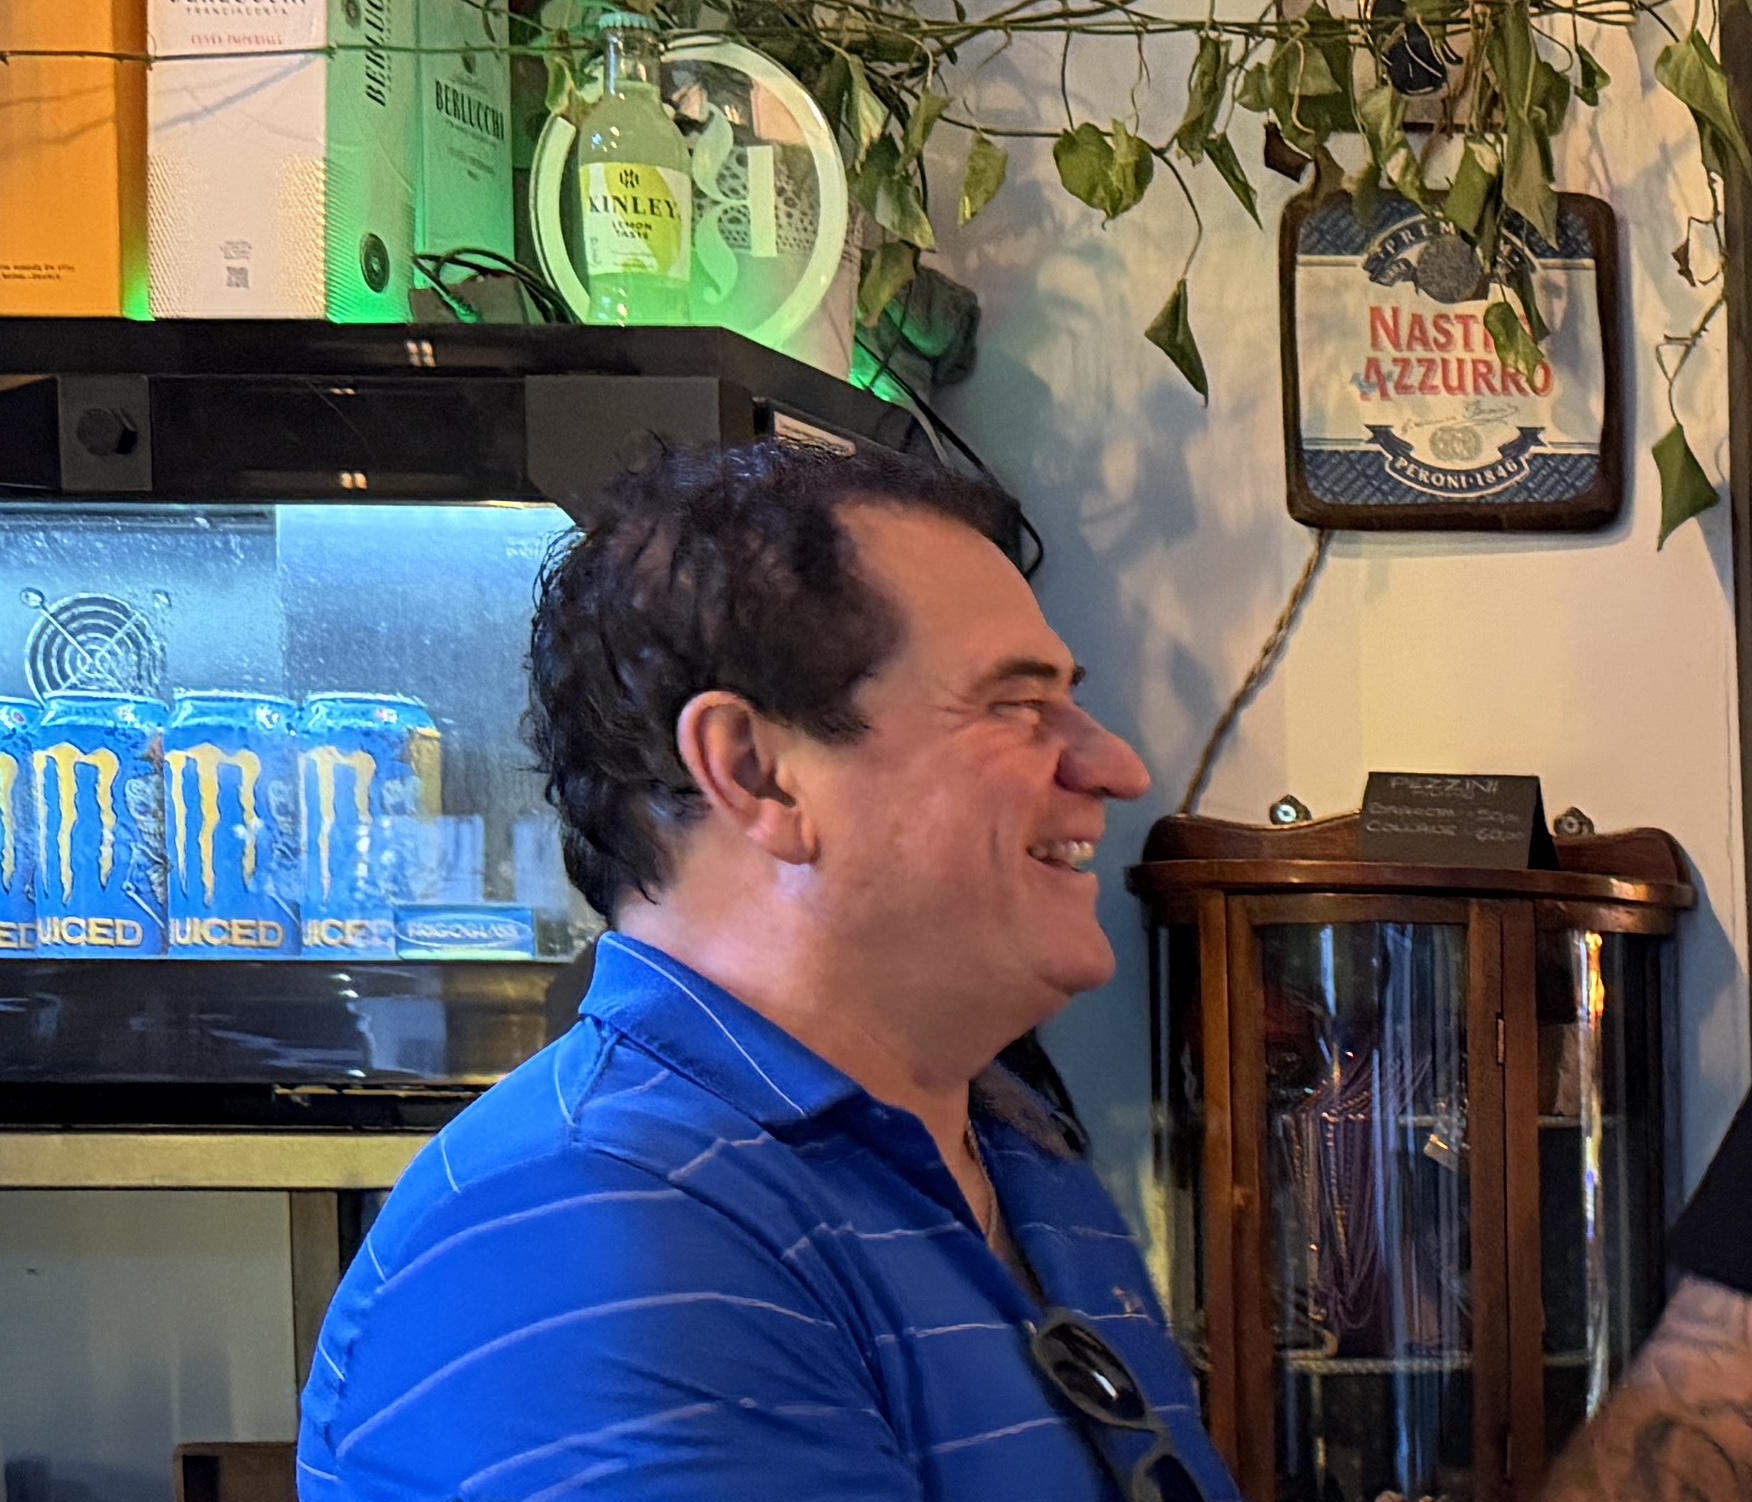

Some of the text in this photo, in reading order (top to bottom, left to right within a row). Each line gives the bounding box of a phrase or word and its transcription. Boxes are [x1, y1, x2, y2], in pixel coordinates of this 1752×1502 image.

[434, 79, 505, 142] BERLUCCHI
[588, 195, 678, 220] KINLEY
[612, 219, 652, 232] LEMON
[615, 230, 649, 241] TASTE
[1358, 357, 1553, 401] AZZURRO
[1393, 456, 1468, 490] PERONI
